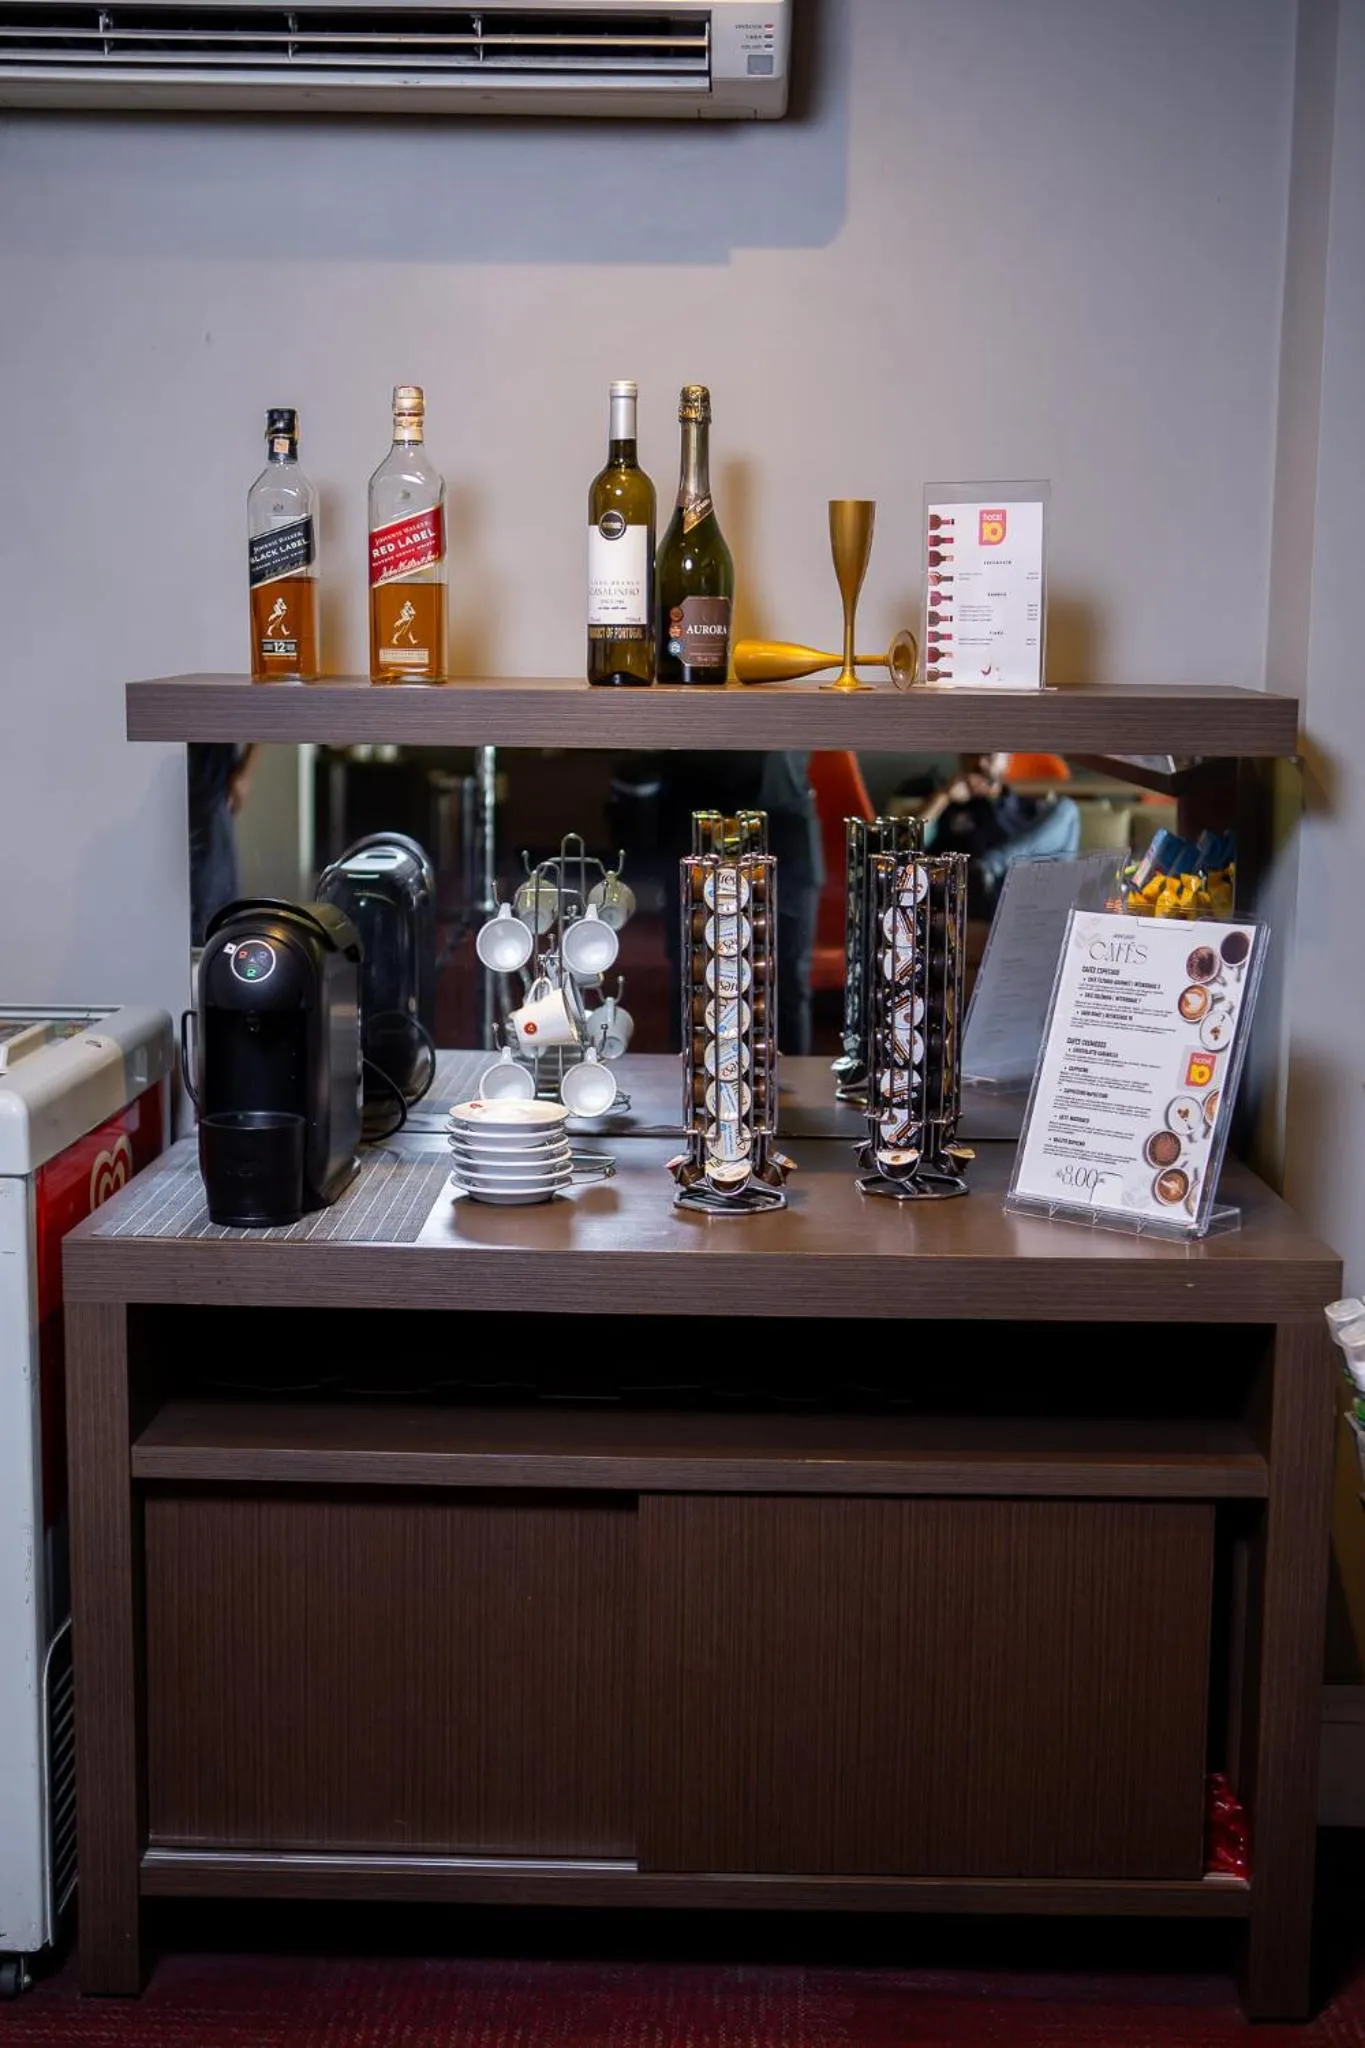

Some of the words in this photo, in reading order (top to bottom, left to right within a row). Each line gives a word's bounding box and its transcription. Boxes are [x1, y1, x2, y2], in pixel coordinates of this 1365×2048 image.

[372, 542, 396, 558] RED
[397, 527, 436, 549] LABEL
[374, 530, 403, 546] JOHNNIE
[250, 548, 279, 564] BLACK
[279, 538, 308, 553] LABEL
[686, 623, 728, 635] AURORA
[273, 642, 286, 653] 12
[1088, 940, 1148, 965] CAFÉS
